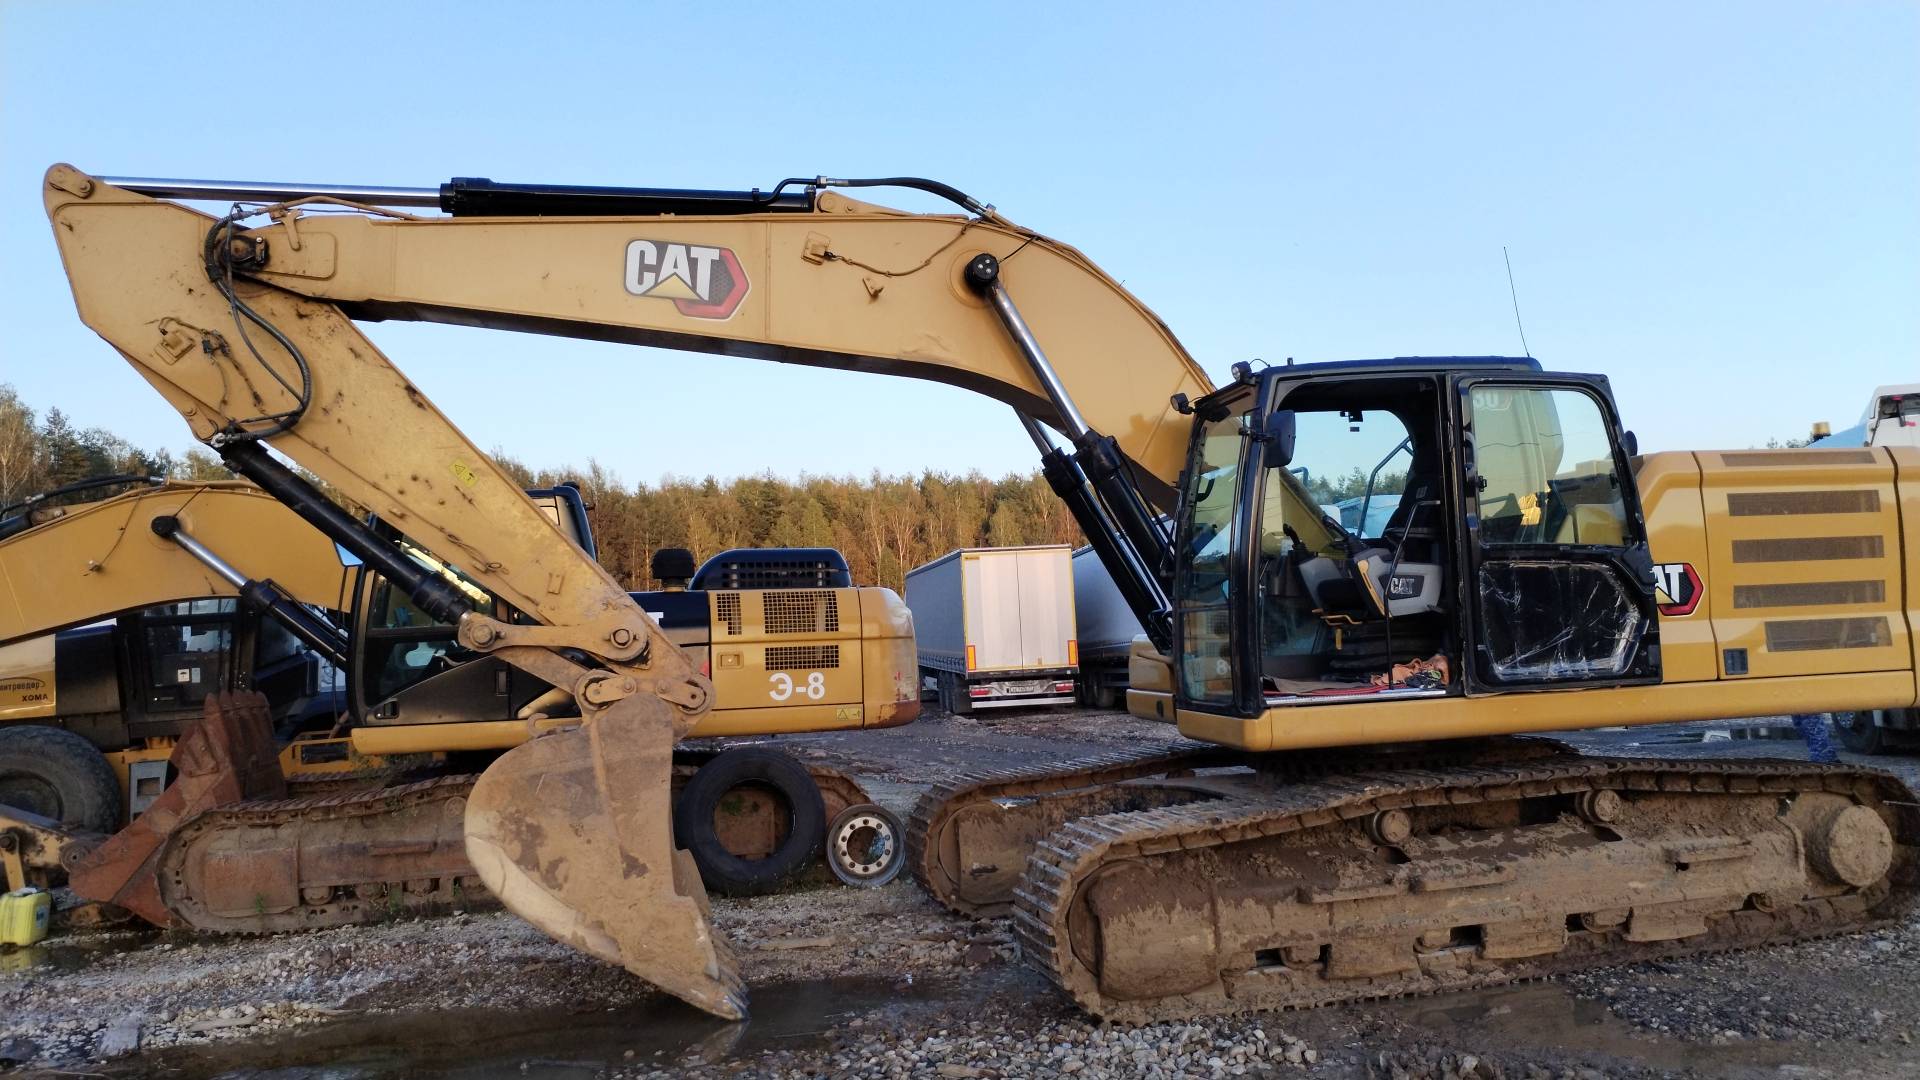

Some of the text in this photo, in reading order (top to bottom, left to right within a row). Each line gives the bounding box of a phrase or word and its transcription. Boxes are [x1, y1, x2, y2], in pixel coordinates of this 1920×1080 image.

[625, 240, 720, 301] CAT
[1390, 577, 1415, 595] CAT
[1651, 564, 1684, 604] AT
[769, 672, 825, 701] Э-8
